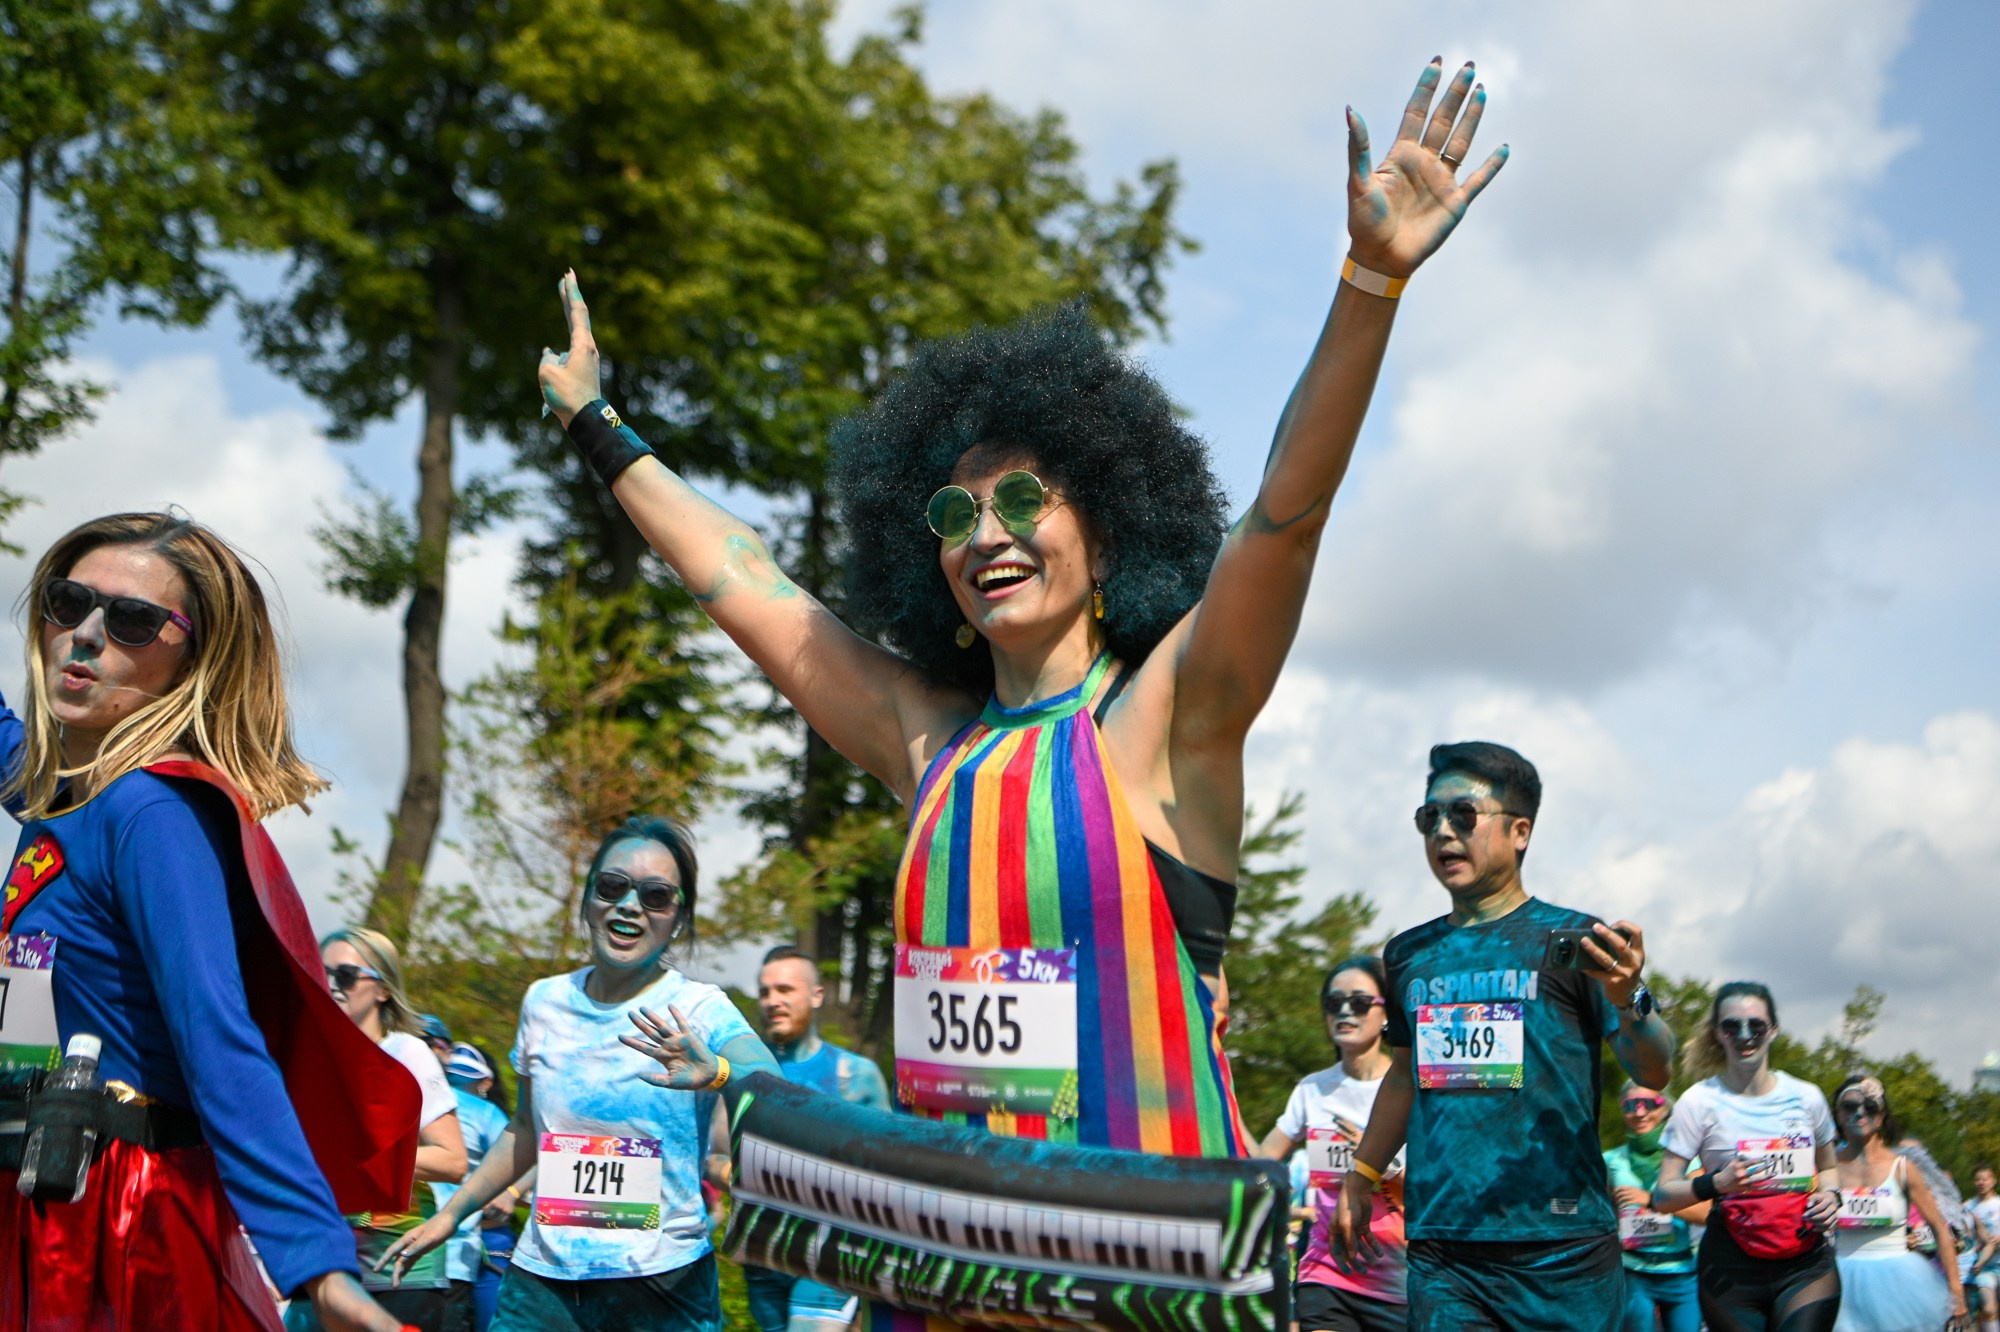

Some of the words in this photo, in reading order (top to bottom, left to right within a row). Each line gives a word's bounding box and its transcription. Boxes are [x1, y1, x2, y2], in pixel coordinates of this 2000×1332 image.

[1429, 969, 1538, 1004] SPARTAN
[928, 991, 1022, 1057] 3565
[1442, 1026, 1495, 1059] 3469
[1327, 1145, 1350, 1168] 121
[573, 1160, 625, 1196] 1214
